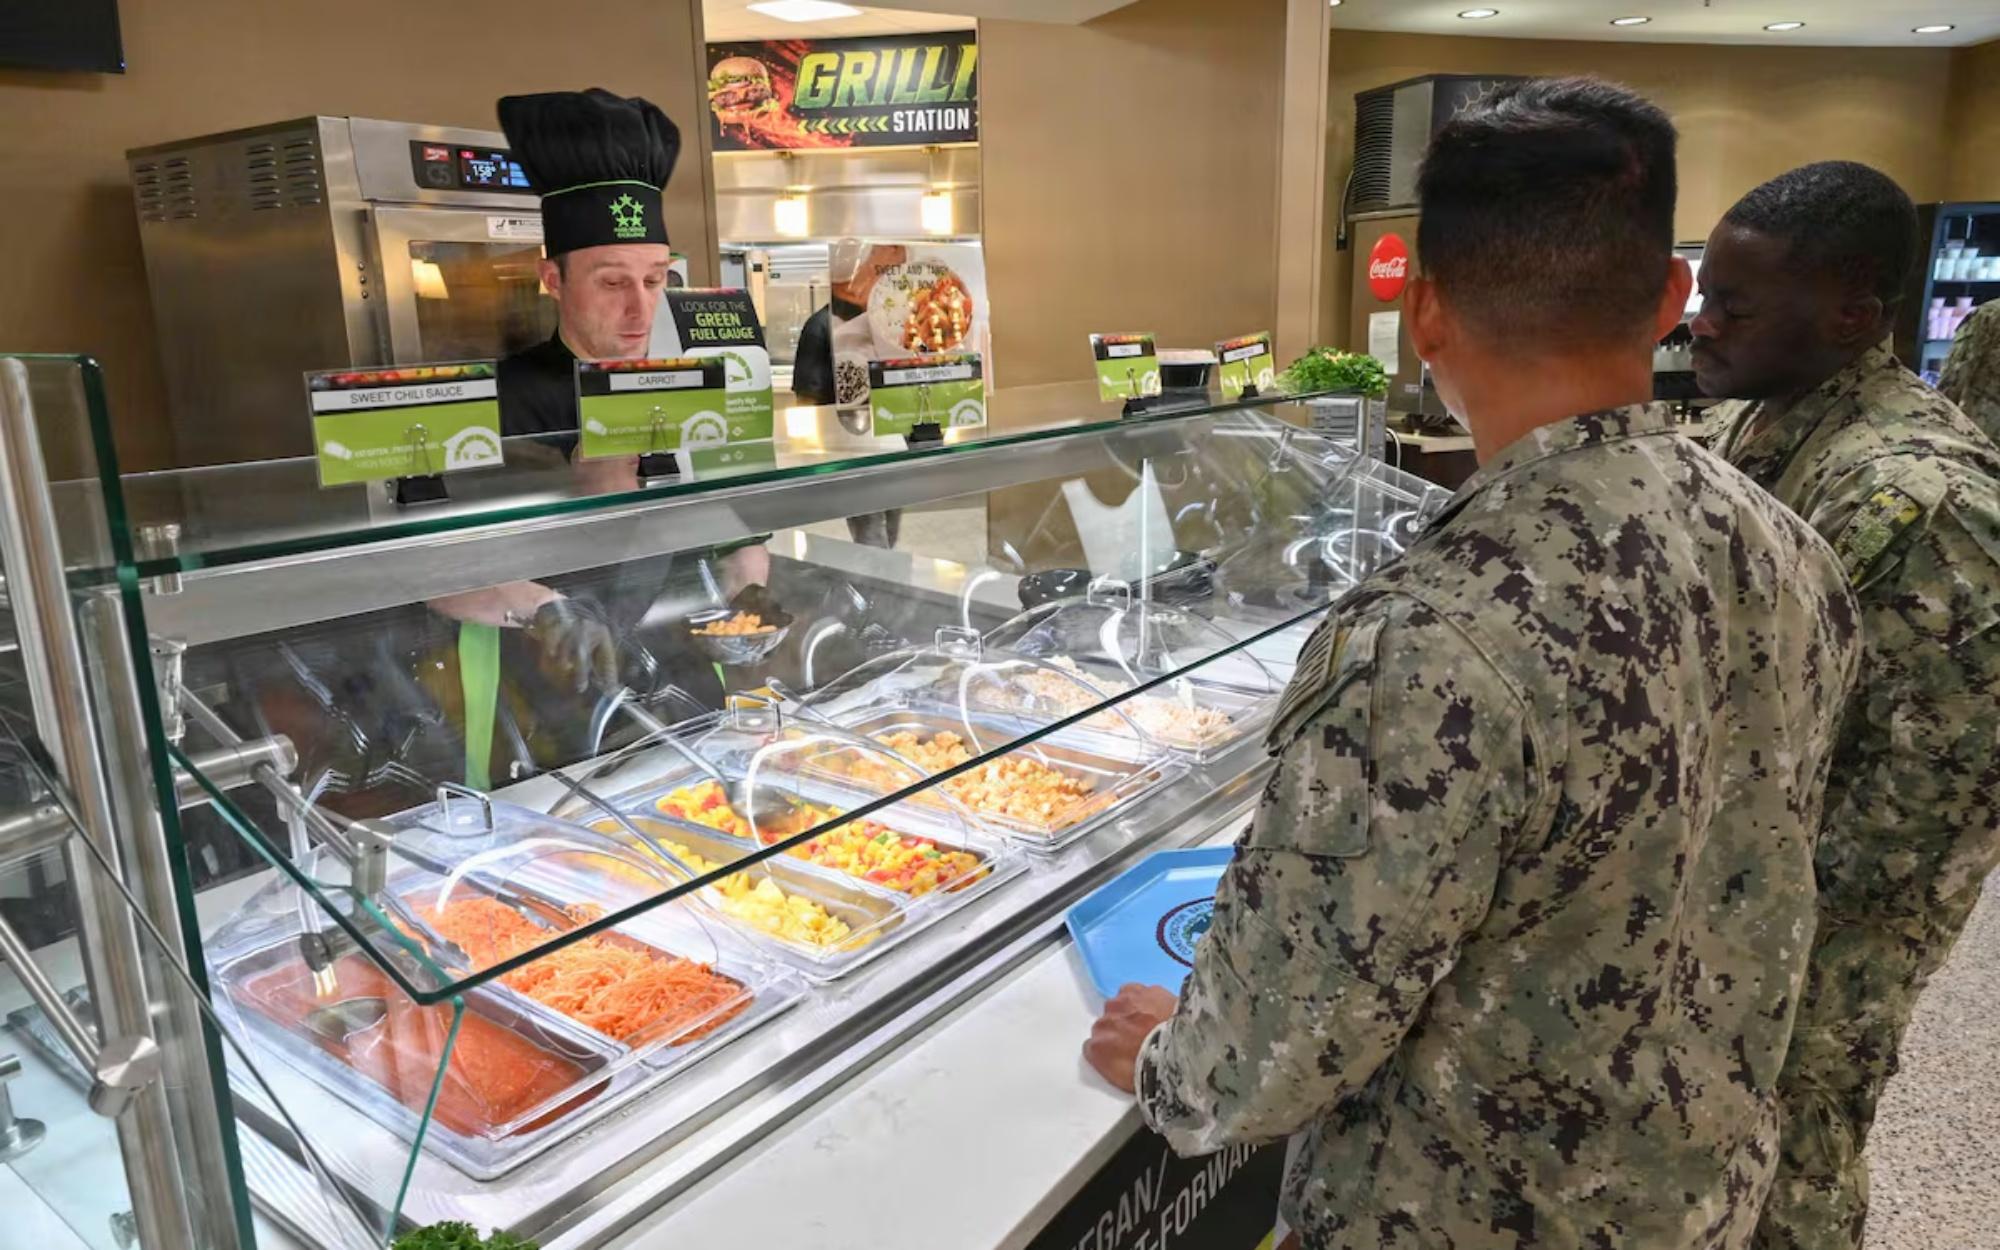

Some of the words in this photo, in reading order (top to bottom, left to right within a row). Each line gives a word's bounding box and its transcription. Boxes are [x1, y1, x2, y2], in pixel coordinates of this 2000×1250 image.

[794, 44, 978, 108] GRILLI
[893, 108, 969, 132] STATION
[681, 301, 707, 312] LOOK
[708, 301, 727, 312] FOR
[730, 301, 747, 312] THE
[695, 312, 741, 327] GREEN
[689, 328, 717, 340] FUEL
[719, 326, 755, 340] GAUGE
[638, 374, 677, 386] CARROT
[351, 391, 392, 405] SWEET
[395, 389, 425, 401] CHILI
[427, 385, 464, 398] SAUCE
